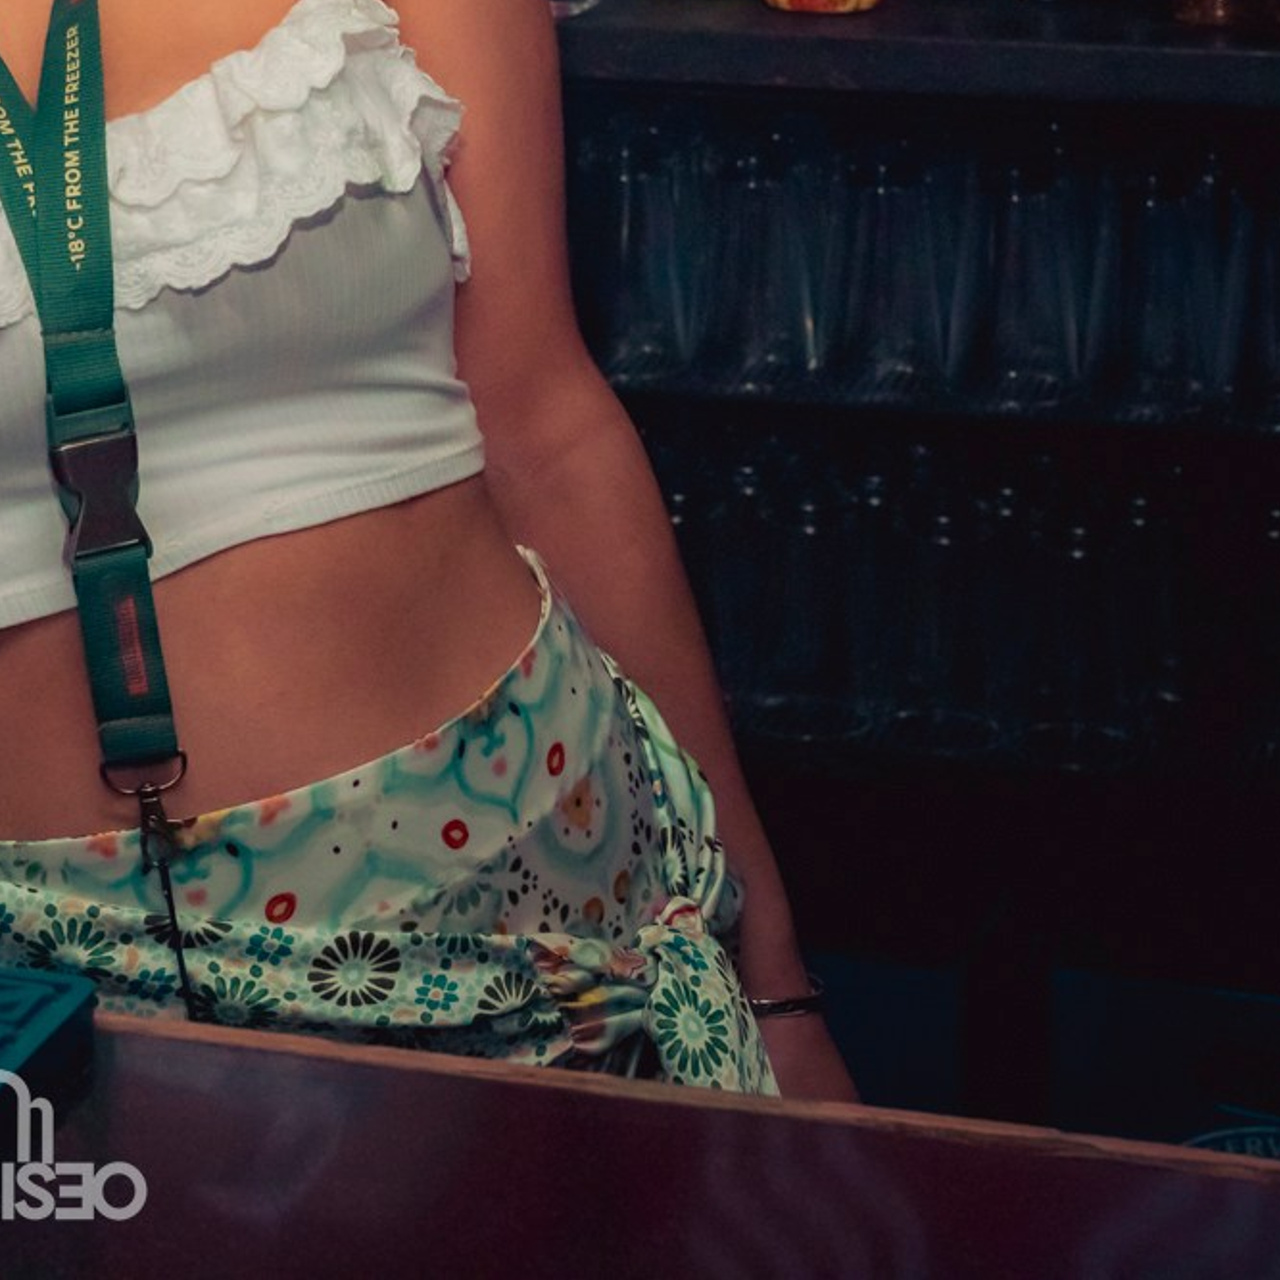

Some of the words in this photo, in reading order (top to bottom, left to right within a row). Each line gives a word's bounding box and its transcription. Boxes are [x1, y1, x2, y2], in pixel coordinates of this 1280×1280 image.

[65, 24, 81, 104] FREEZER
[64, 106, 80, 147] THE
[6, 137, 34, 177] THE
[66, 148, 82, 210] FROM
